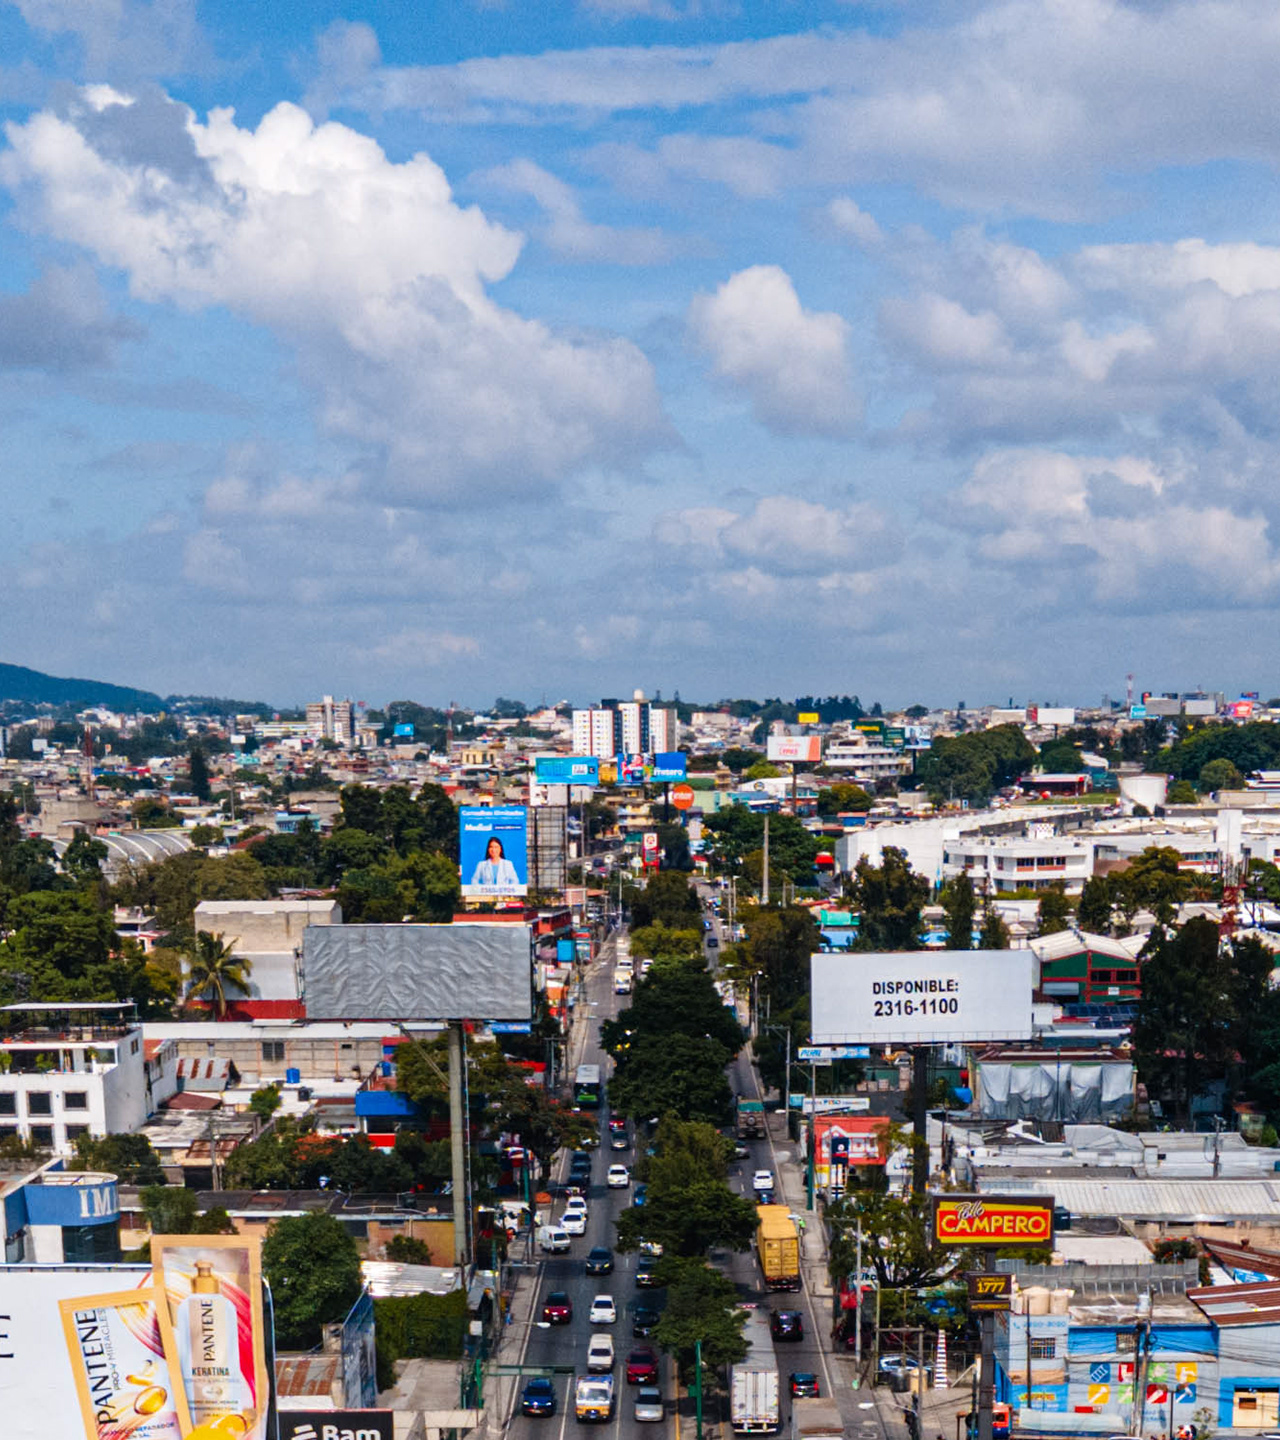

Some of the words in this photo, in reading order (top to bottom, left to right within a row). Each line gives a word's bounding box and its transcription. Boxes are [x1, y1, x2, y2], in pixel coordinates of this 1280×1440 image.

[872, 979, 959, 996] DISPONIBLE:
[873, 998, 959, 1017] 2316-1100
[940, 1213, 1048, 1236] CAMPERO
[202, 1299, 214, 1363] PANTENE
[75, 1308, 119, 1426] PANTENE
